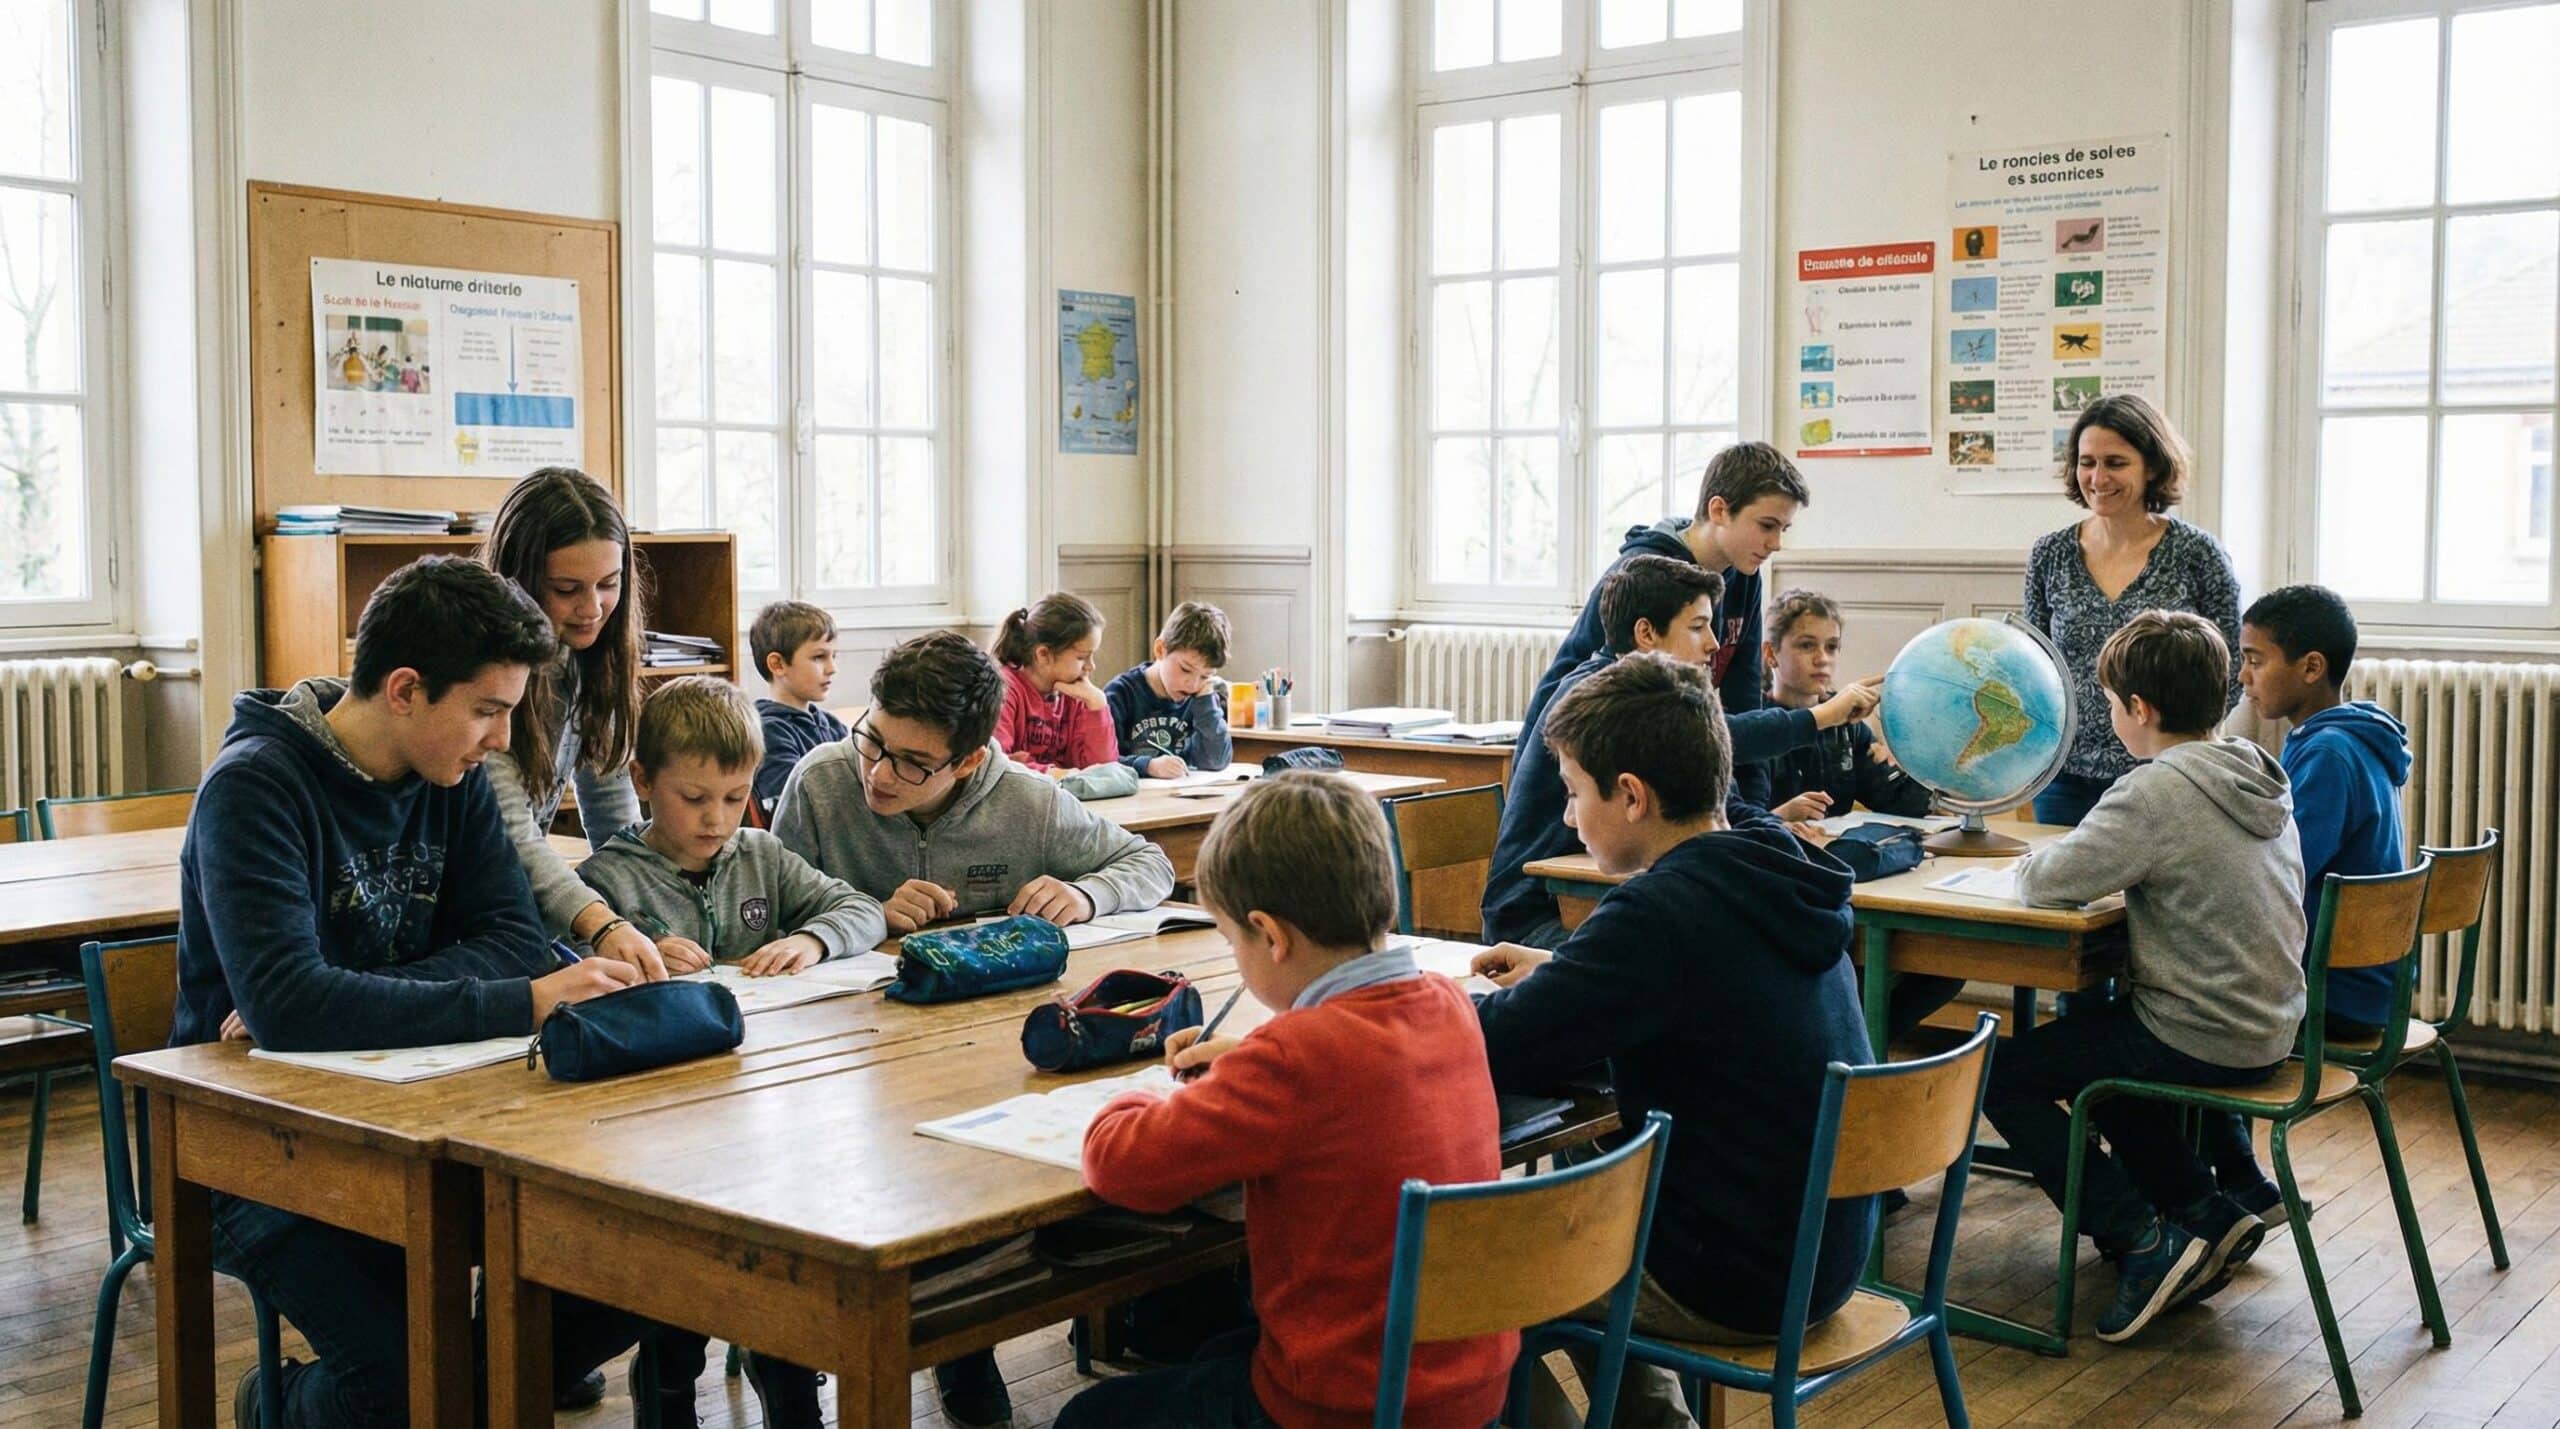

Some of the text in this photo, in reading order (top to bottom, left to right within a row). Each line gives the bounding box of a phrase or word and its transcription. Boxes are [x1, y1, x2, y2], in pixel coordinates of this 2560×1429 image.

[1979, 157, 1998, 171] Le
[2003, 151, 2060, 169] roncies
[2065, 148, 2084, 162] de
[2007, 175, 2026, 186] es
[376, 271, 396, 287] Le
